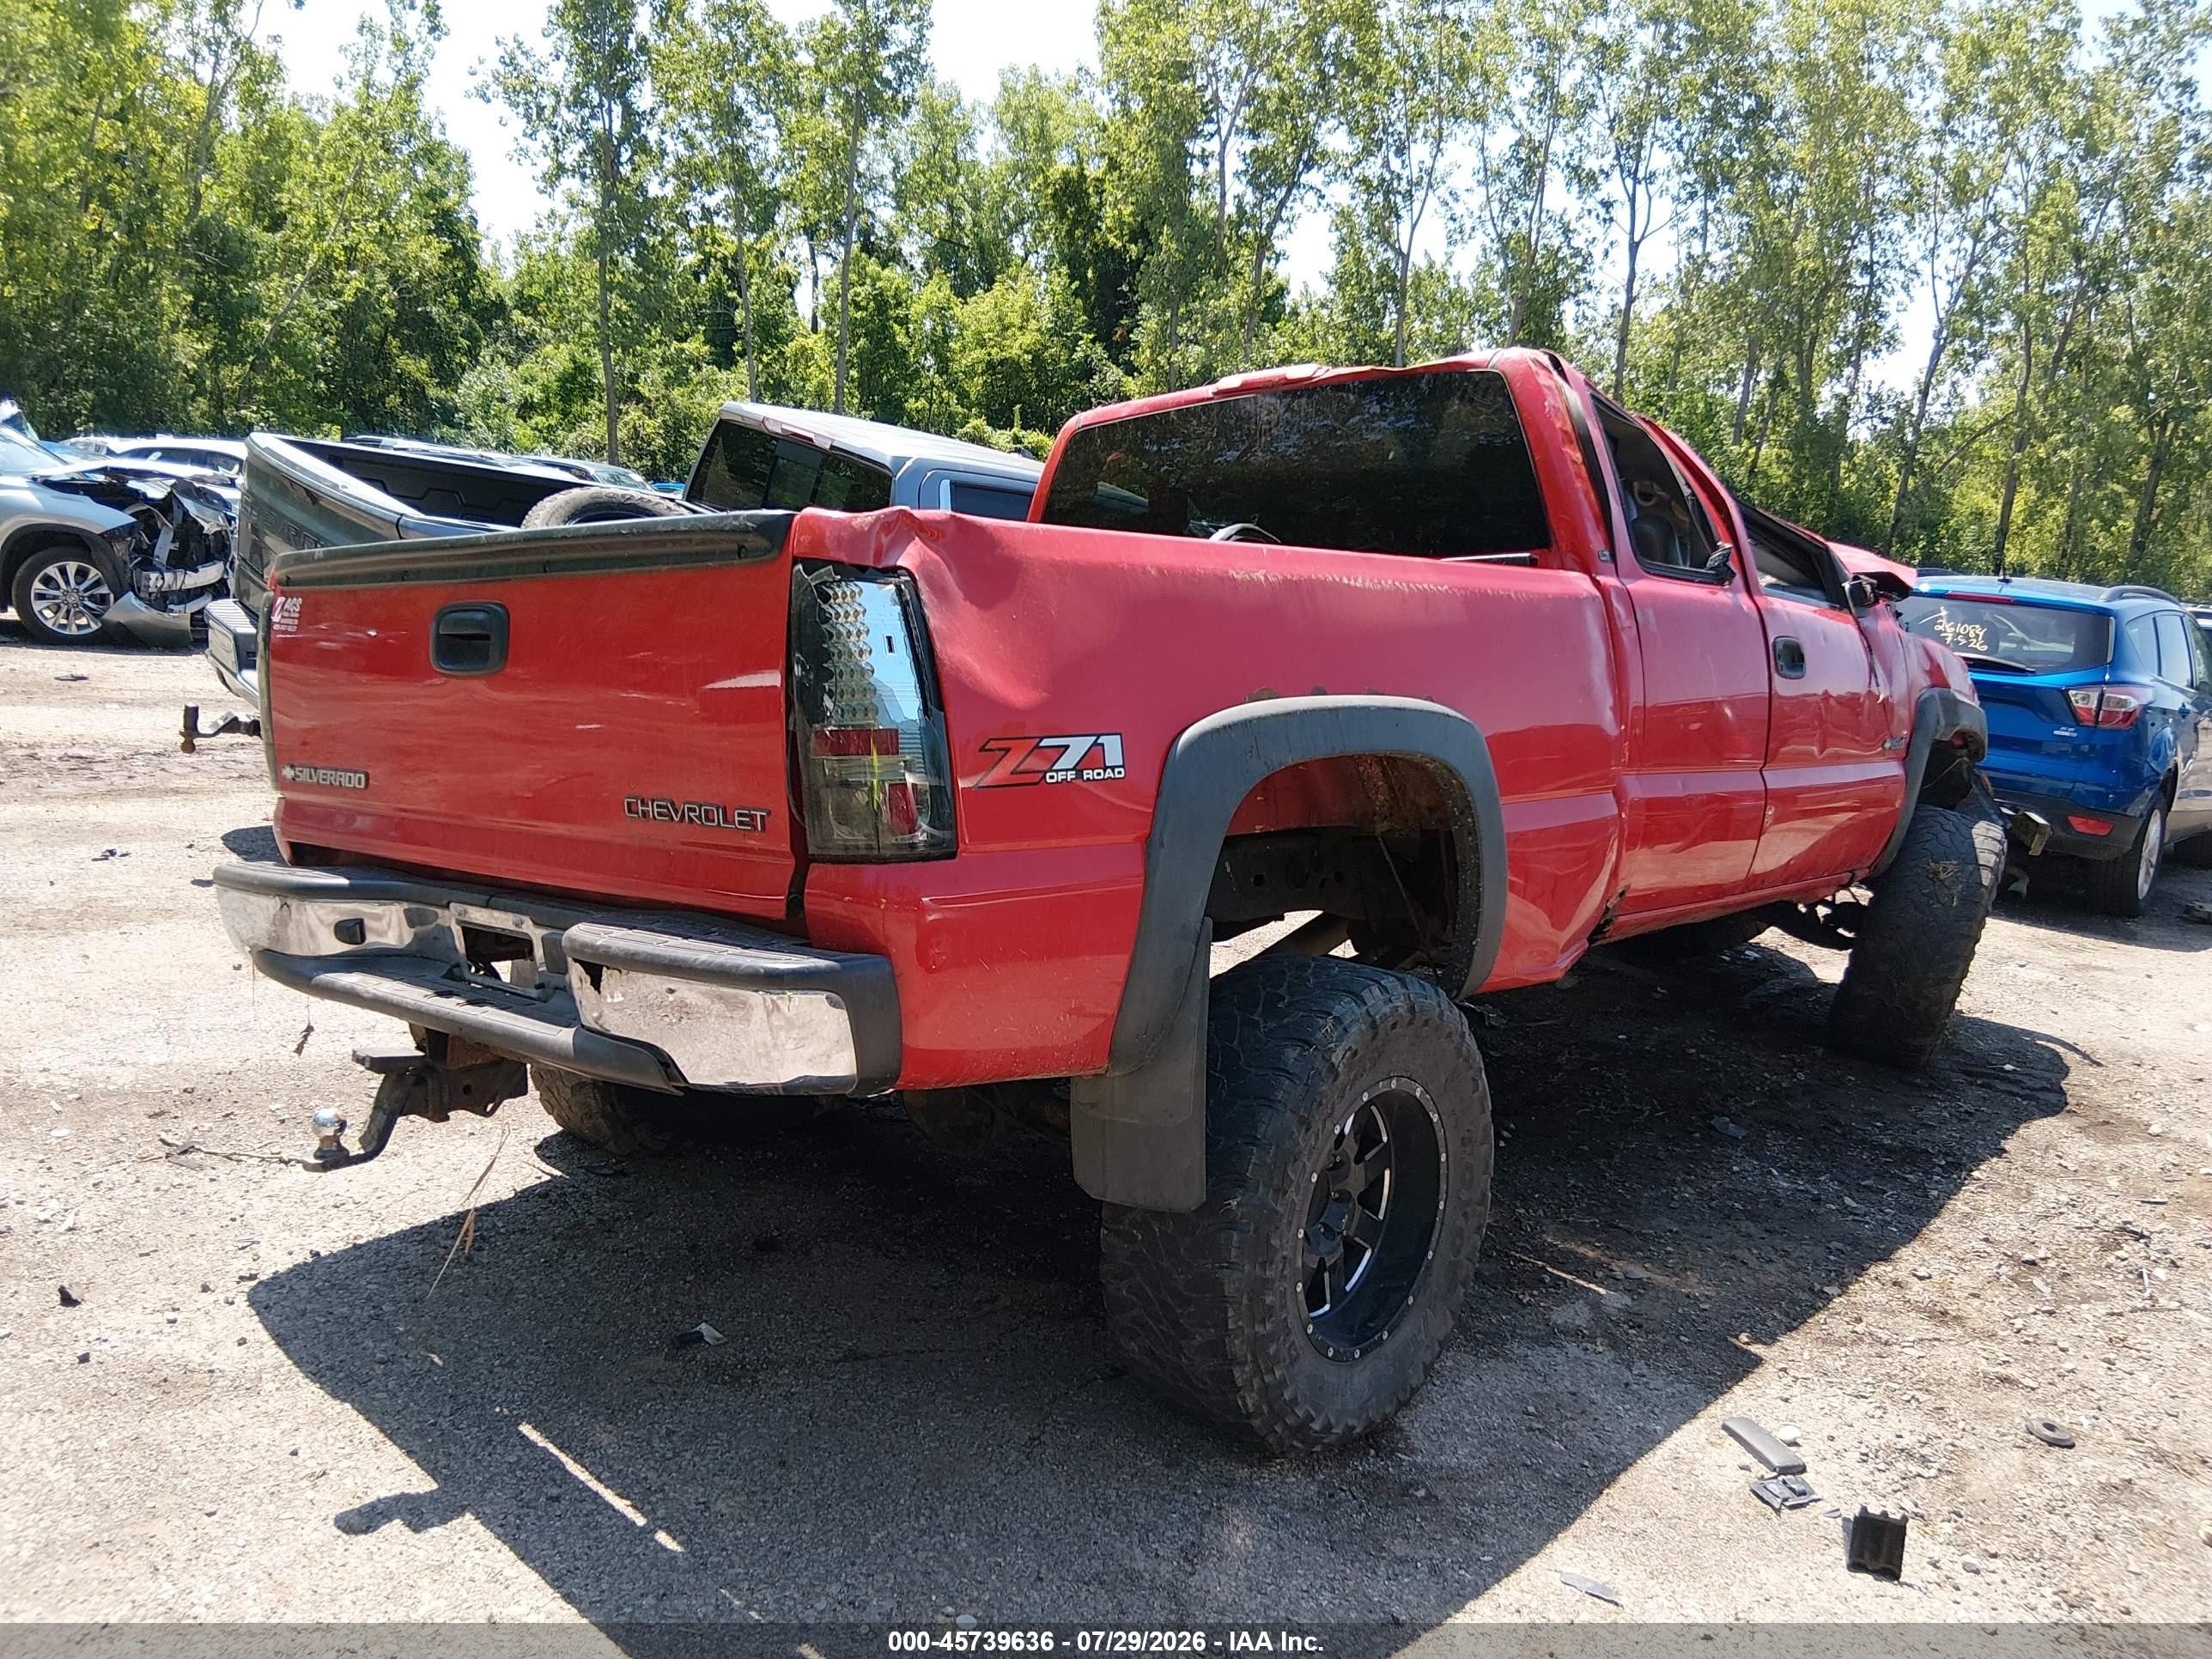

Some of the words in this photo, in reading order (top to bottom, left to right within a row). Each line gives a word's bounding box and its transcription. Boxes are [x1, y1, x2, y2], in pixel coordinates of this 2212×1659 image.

[973, 732, 1126, 789] Z71
[295, 767, 367, 788] SILVERADO
[1045, 771, 1076, 784] OFF
[1083, 768, 1126, 781] ROAD
[624, 798, 768, 832] CHEVROLET
